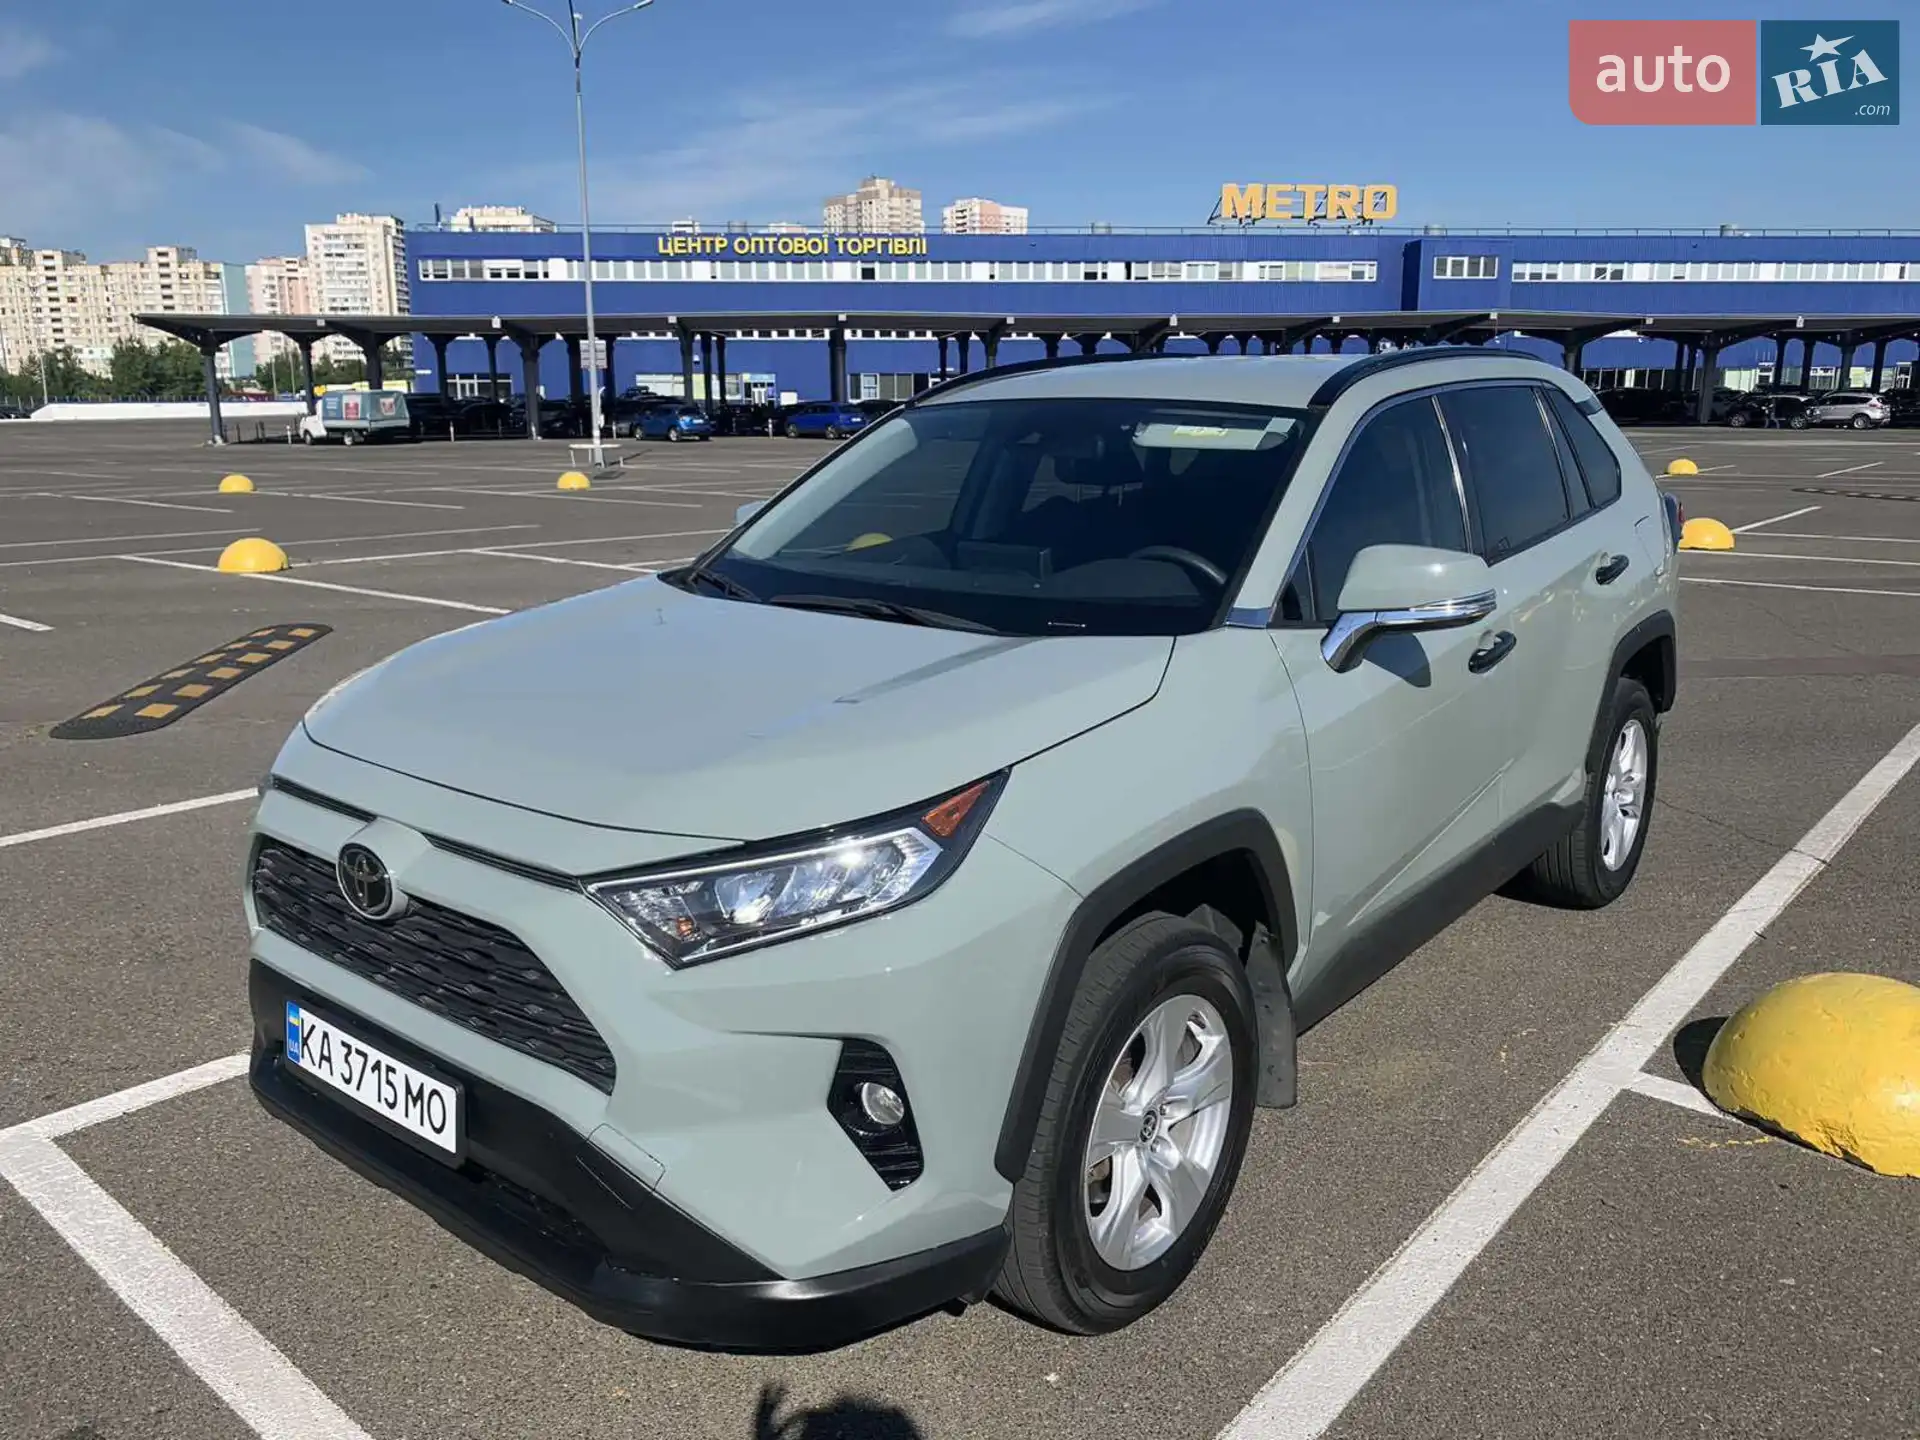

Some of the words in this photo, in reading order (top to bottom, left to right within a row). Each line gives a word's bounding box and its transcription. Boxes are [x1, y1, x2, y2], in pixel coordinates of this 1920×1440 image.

[1221, 183, 1397, 220] METRO
[658, 236, 728, 256] ЦЕНТР
[733, 234, 829, 255] ОПТОВОЇ
[835, 236, 927, 256] ТОРГІВЛІ
[340, 1040, 398, 1110] 3715
